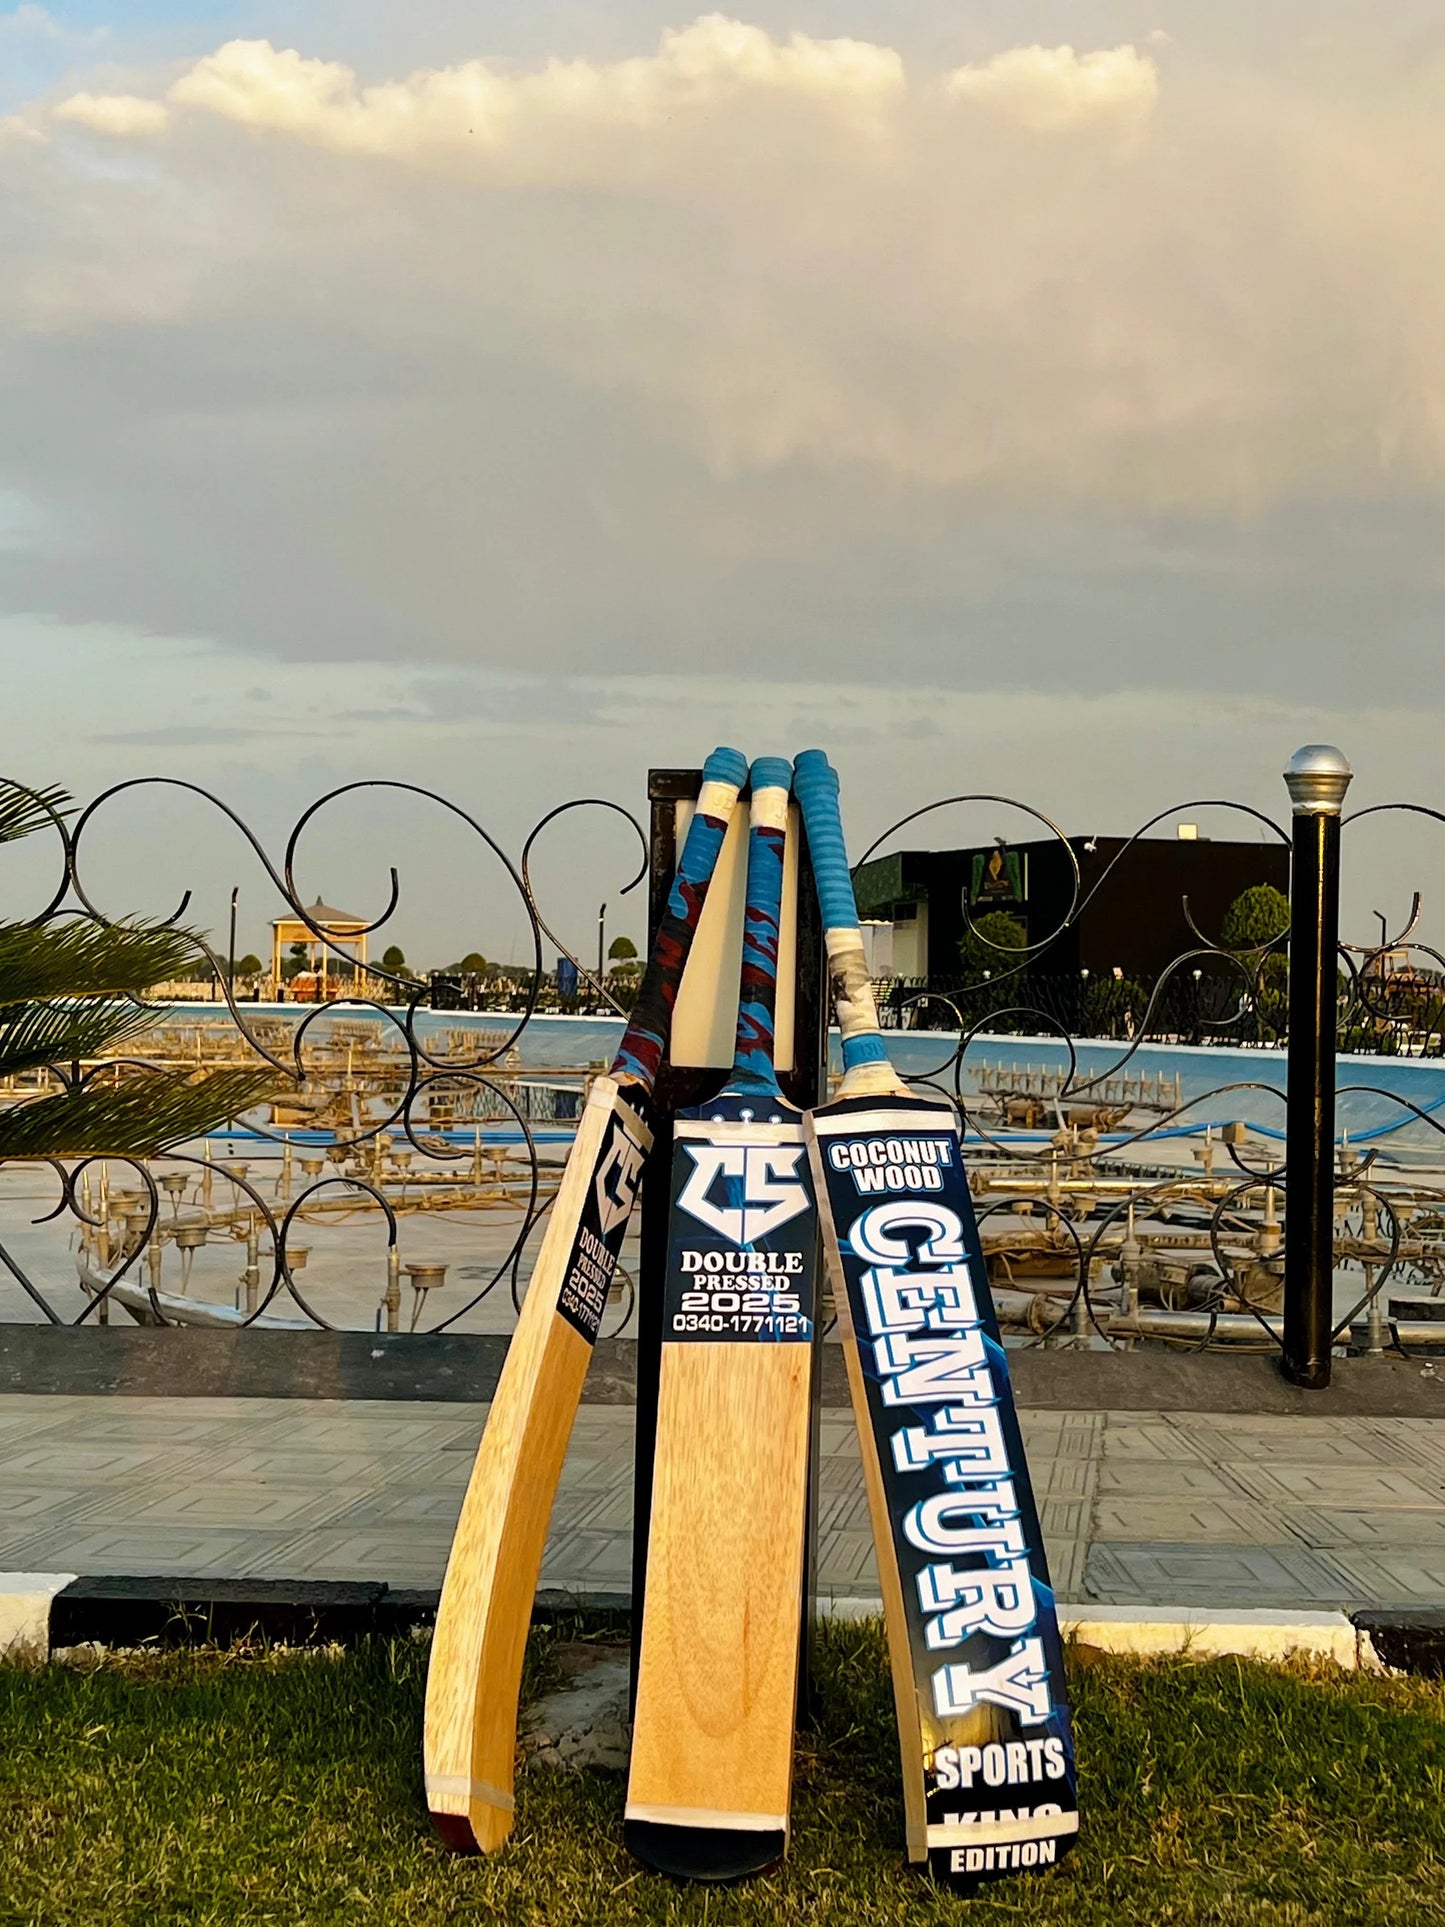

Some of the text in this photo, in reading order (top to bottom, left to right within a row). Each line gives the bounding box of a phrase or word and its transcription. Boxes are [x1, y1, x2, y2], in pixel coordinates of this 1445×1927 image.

[830, 1140, 951, 1166] COCONUT
[855, 1166, 943, 1192] WOOD
[579, 1226, 615, 1276] DOUBLE
[680, 1251, 803, 1273] DOUBLE
[569, 1267, 604, 1313] 2025
[693, 1275, 790, 1291] PRESSED
[681, 1293, 800, 1312] 2025
[672, 1314, 808, 1333] 0340-1771121
[848, 1200, 1056, 1727] CENTURY
[935, 1738, 1066, 1790] SPORTS
[950, 1839, 1056, 1873] EDITION
